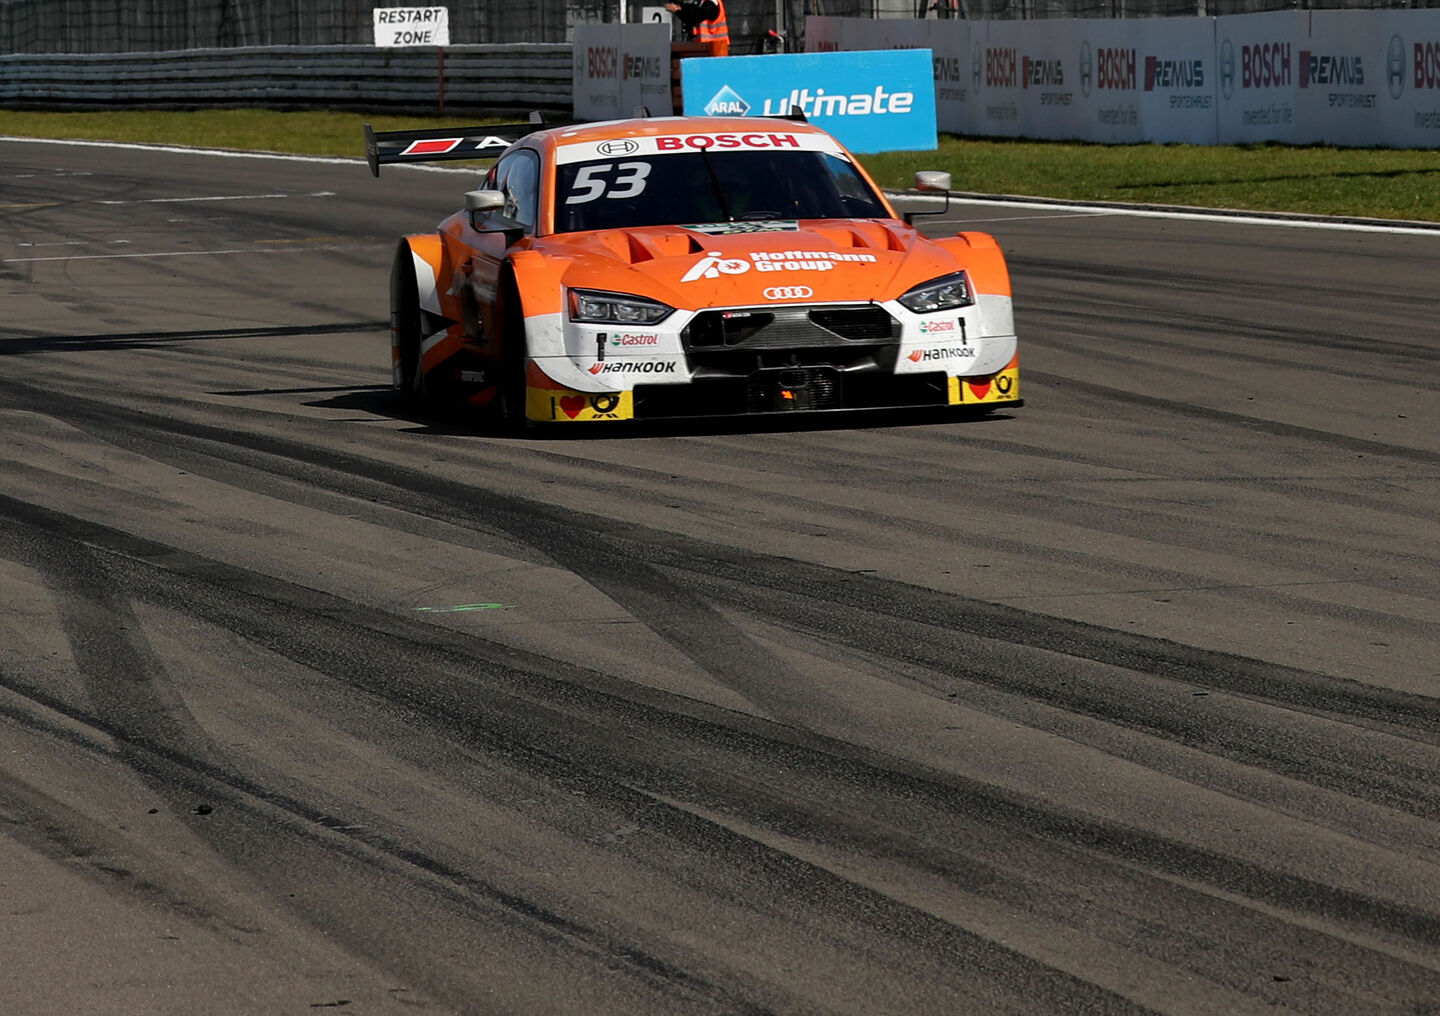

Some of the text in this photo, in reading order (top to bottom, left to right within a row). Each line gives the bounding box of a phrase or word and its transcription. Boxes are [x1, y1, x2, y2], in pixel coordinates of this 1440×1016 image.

[378, 9, 442, 23] RESTART
[394, 31, 431, 44] ZONE
[587, 47, 618, 79] BOSCH
[986, 48, 1017, 87] BOSCH
[1097, 48, 1137, 90] BOSCH
[1156, 60, 1204, 87] REMUS
[1242, 42, 1291, 89] BOSCH
[1310, 56, 1365, 85] REMUS
[711, 101, 744, 114] ARAL
[763, 85, 914, 117] ultimate
[655, 134, 801, 151] BOSCH
[565, 161, 652, 205] 53
[749, 250, 878, 264] Hoffmann
[754, 259, 835, 273] Group
[621, 333, 658, 346] Castrol
